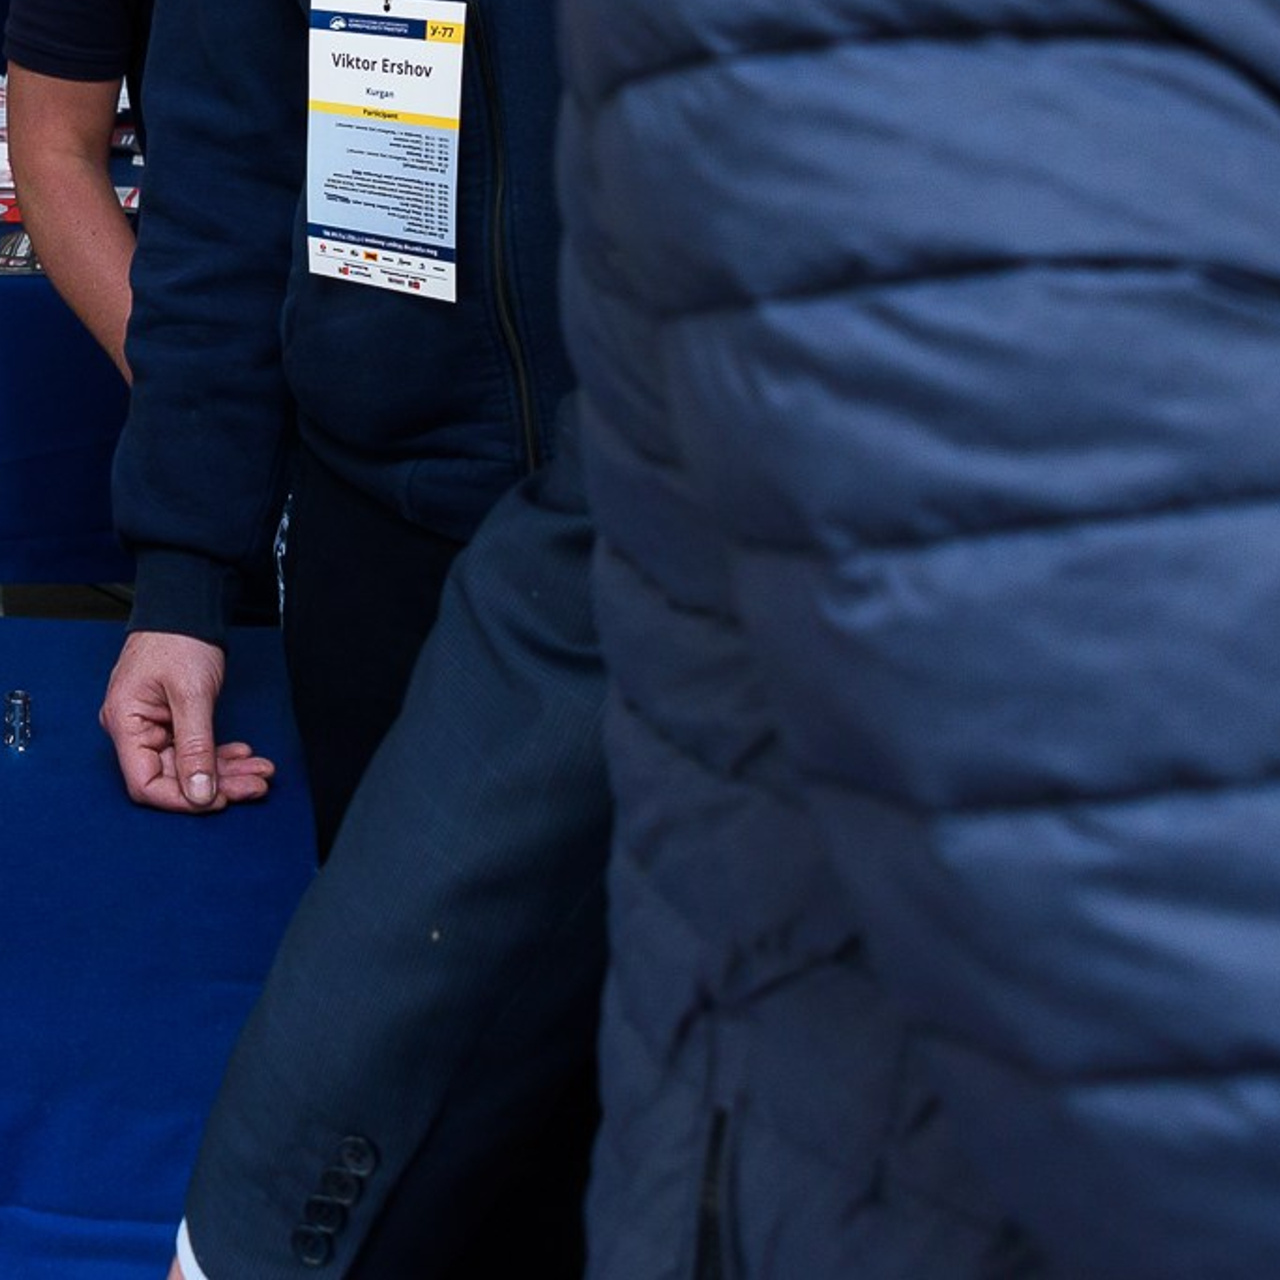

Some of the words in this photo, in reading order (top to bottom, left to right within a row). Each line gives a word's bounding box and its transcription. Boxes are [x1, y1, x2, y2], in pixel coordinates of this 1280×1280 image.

[331, 52, 377, 72] Viktor
[381, 58, 433, 78] Ershov
[365, 86, 394, 99] Kurgan
